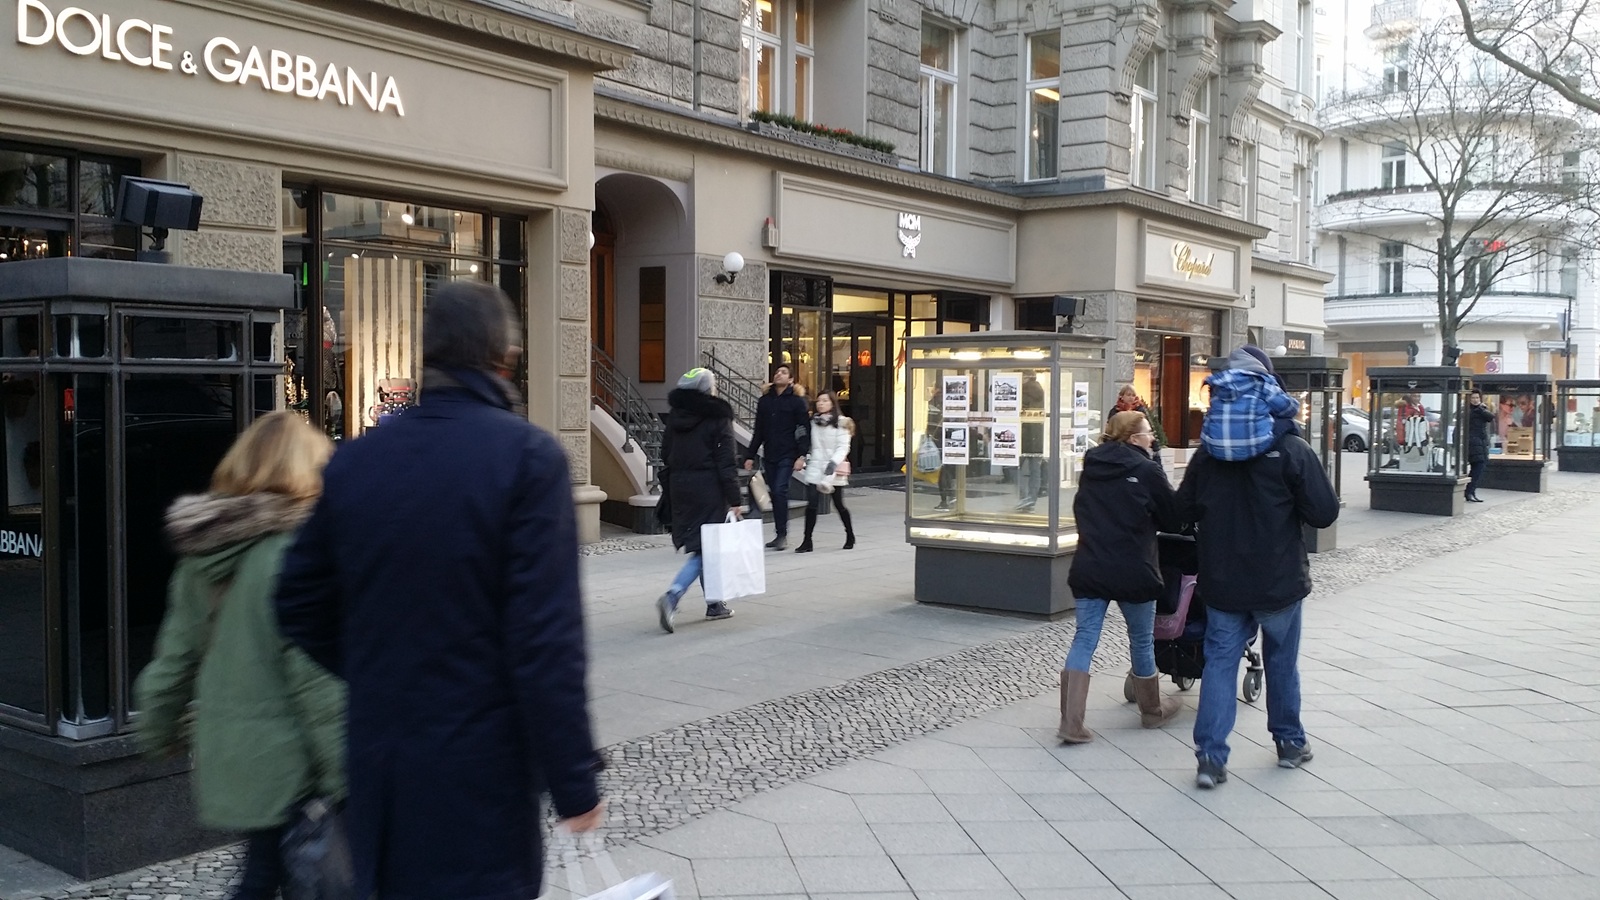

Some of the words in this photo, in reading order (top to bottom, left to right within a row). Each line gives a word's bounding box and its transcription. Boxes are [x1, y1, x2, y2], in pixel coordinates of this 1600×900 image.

[16, 0, 173, 70] DOLCE
[180, 50, 199, 75] &
[203, 36, 405, 117] GABBANA
[899, 212, 921, 231] MCM
[1173, 241, 1215, 279] Chopard
